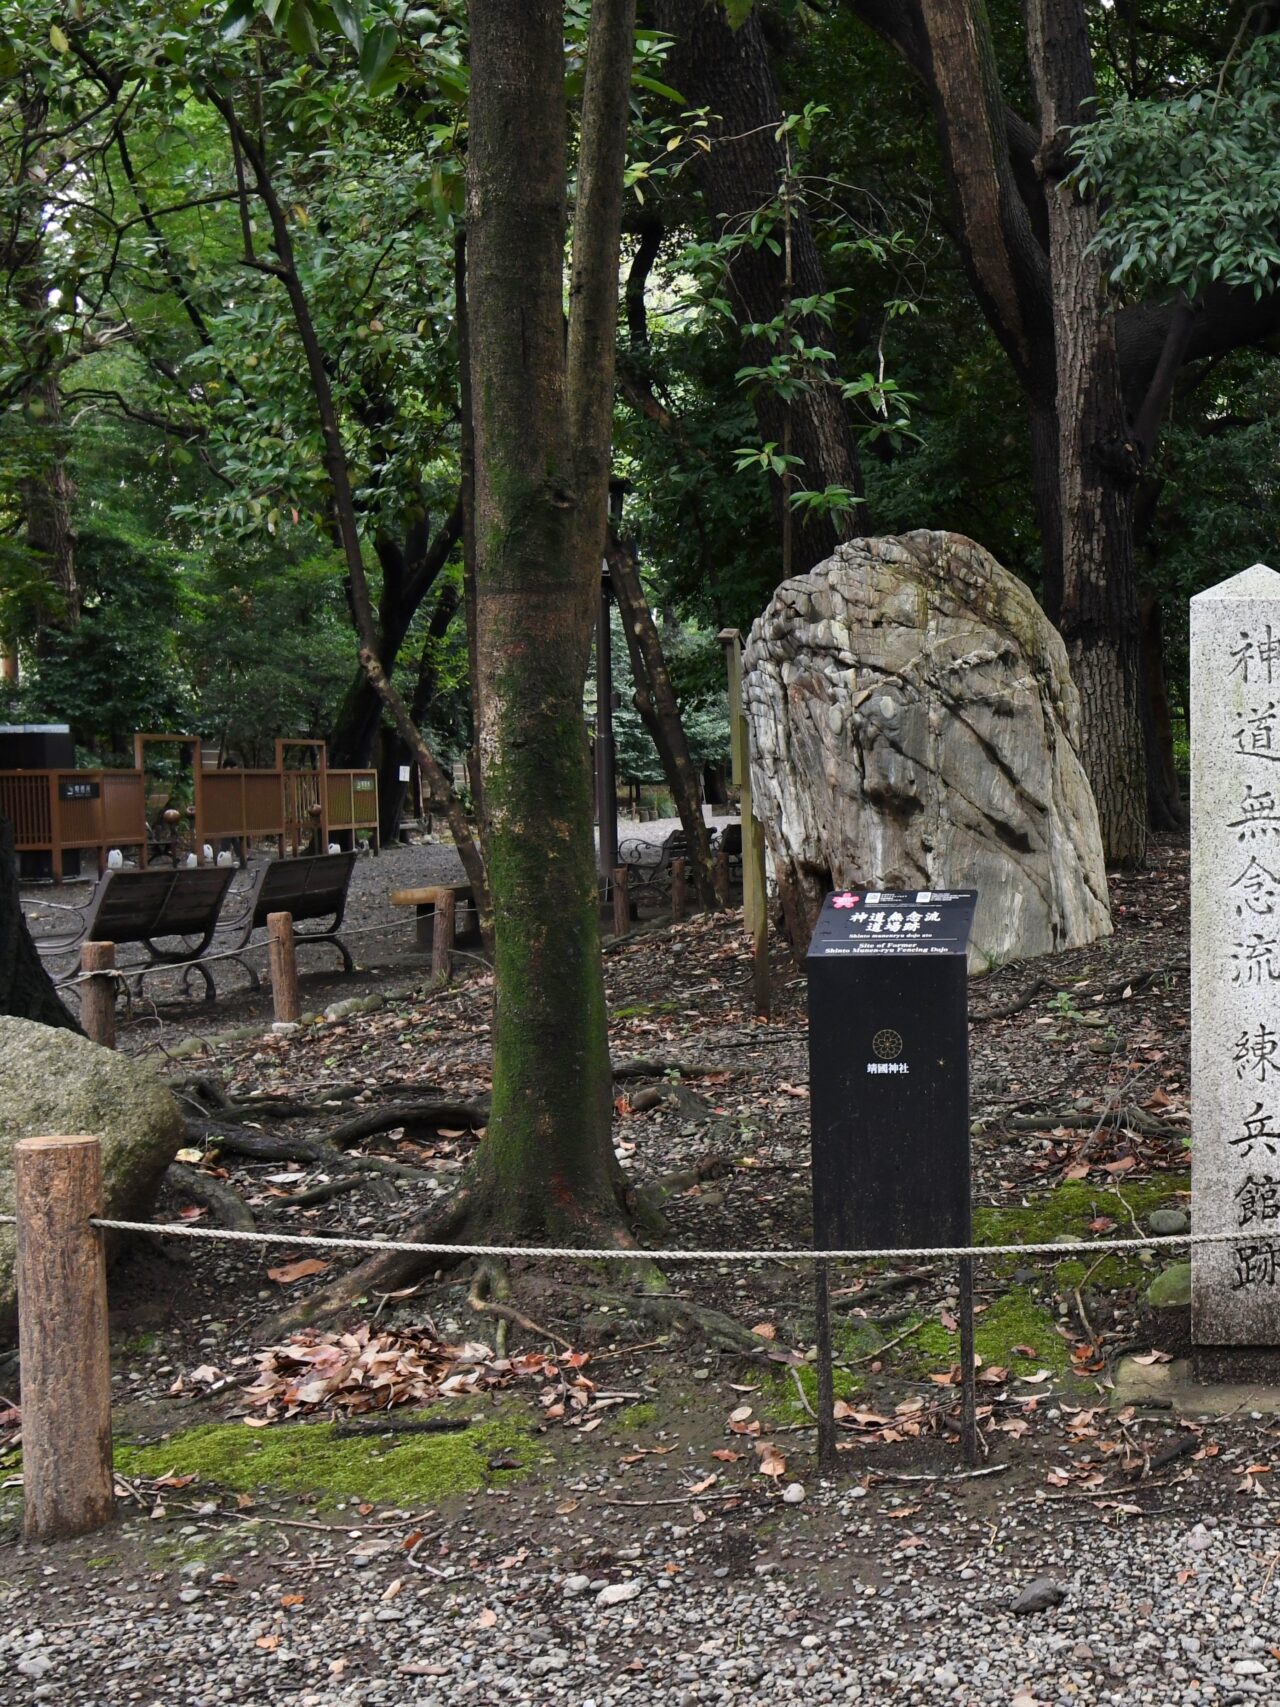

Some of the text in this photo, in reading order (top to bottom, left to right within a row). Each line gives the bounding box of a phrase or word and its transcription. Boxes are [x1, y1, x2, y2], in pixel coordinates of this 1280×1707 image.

[849, 911, 942, 923] 神道無念流
[865, 922, 921, 933] 道場跡
[852, 947, 895, 955] Munen-ryu
[867, 1063, 910, 1074] 靖國神社
